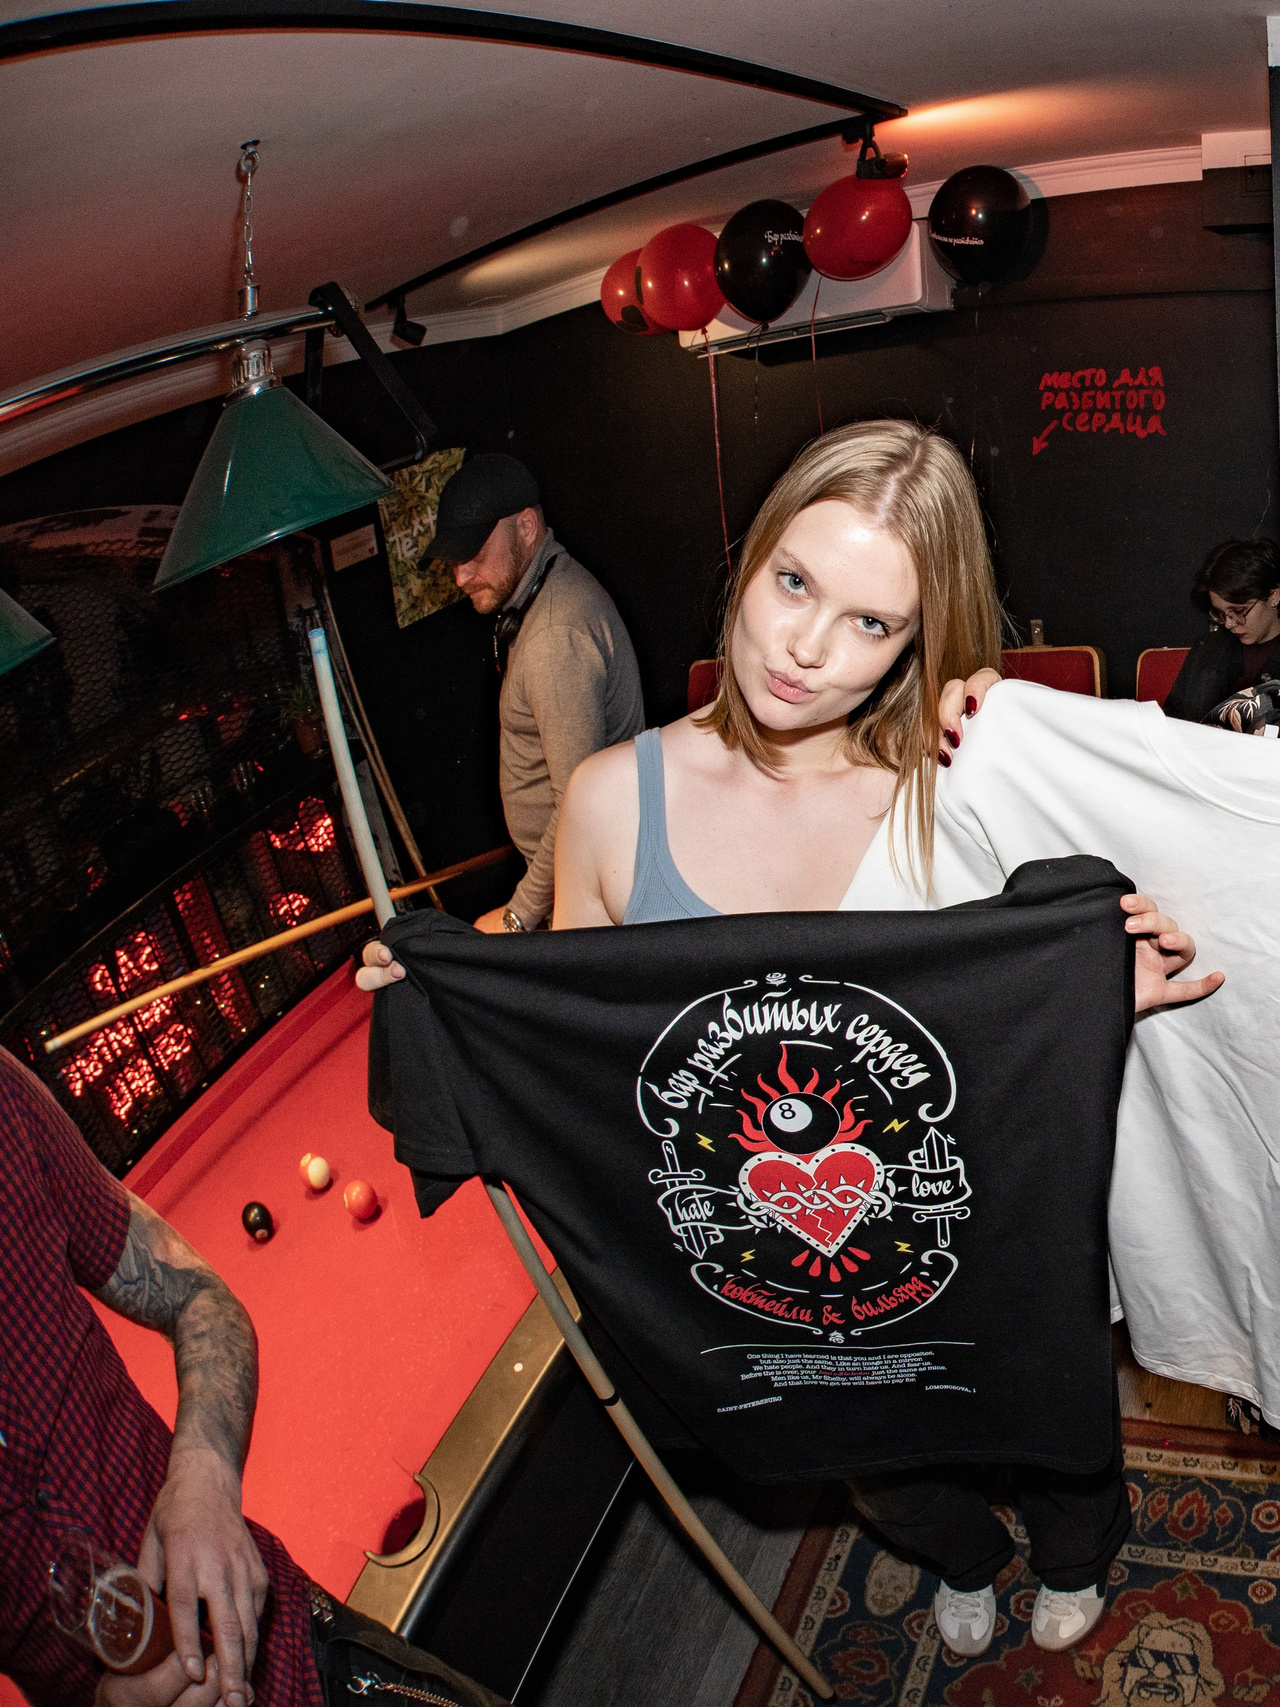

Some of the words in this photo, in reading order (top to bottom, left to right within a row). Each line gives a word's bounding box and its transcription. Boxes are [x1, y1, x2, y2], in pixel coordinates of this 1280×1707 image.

[645, 1069, 715, 1110] бар
[686, 988, 842, 1081] разбитых
[845, 1013, 932, 1090] сердец
[779, 1103, 797, 1120] 8
[911, 1172, 955, 1197] love
[675, 1190, 717, 1221] hate
[720, 1276, 814, 1323] коктейли
[822, 1304, 846, 1326] &
[851, 1276, 936, 1321] бильярд
[740, 1372, 762, 1380] Before
